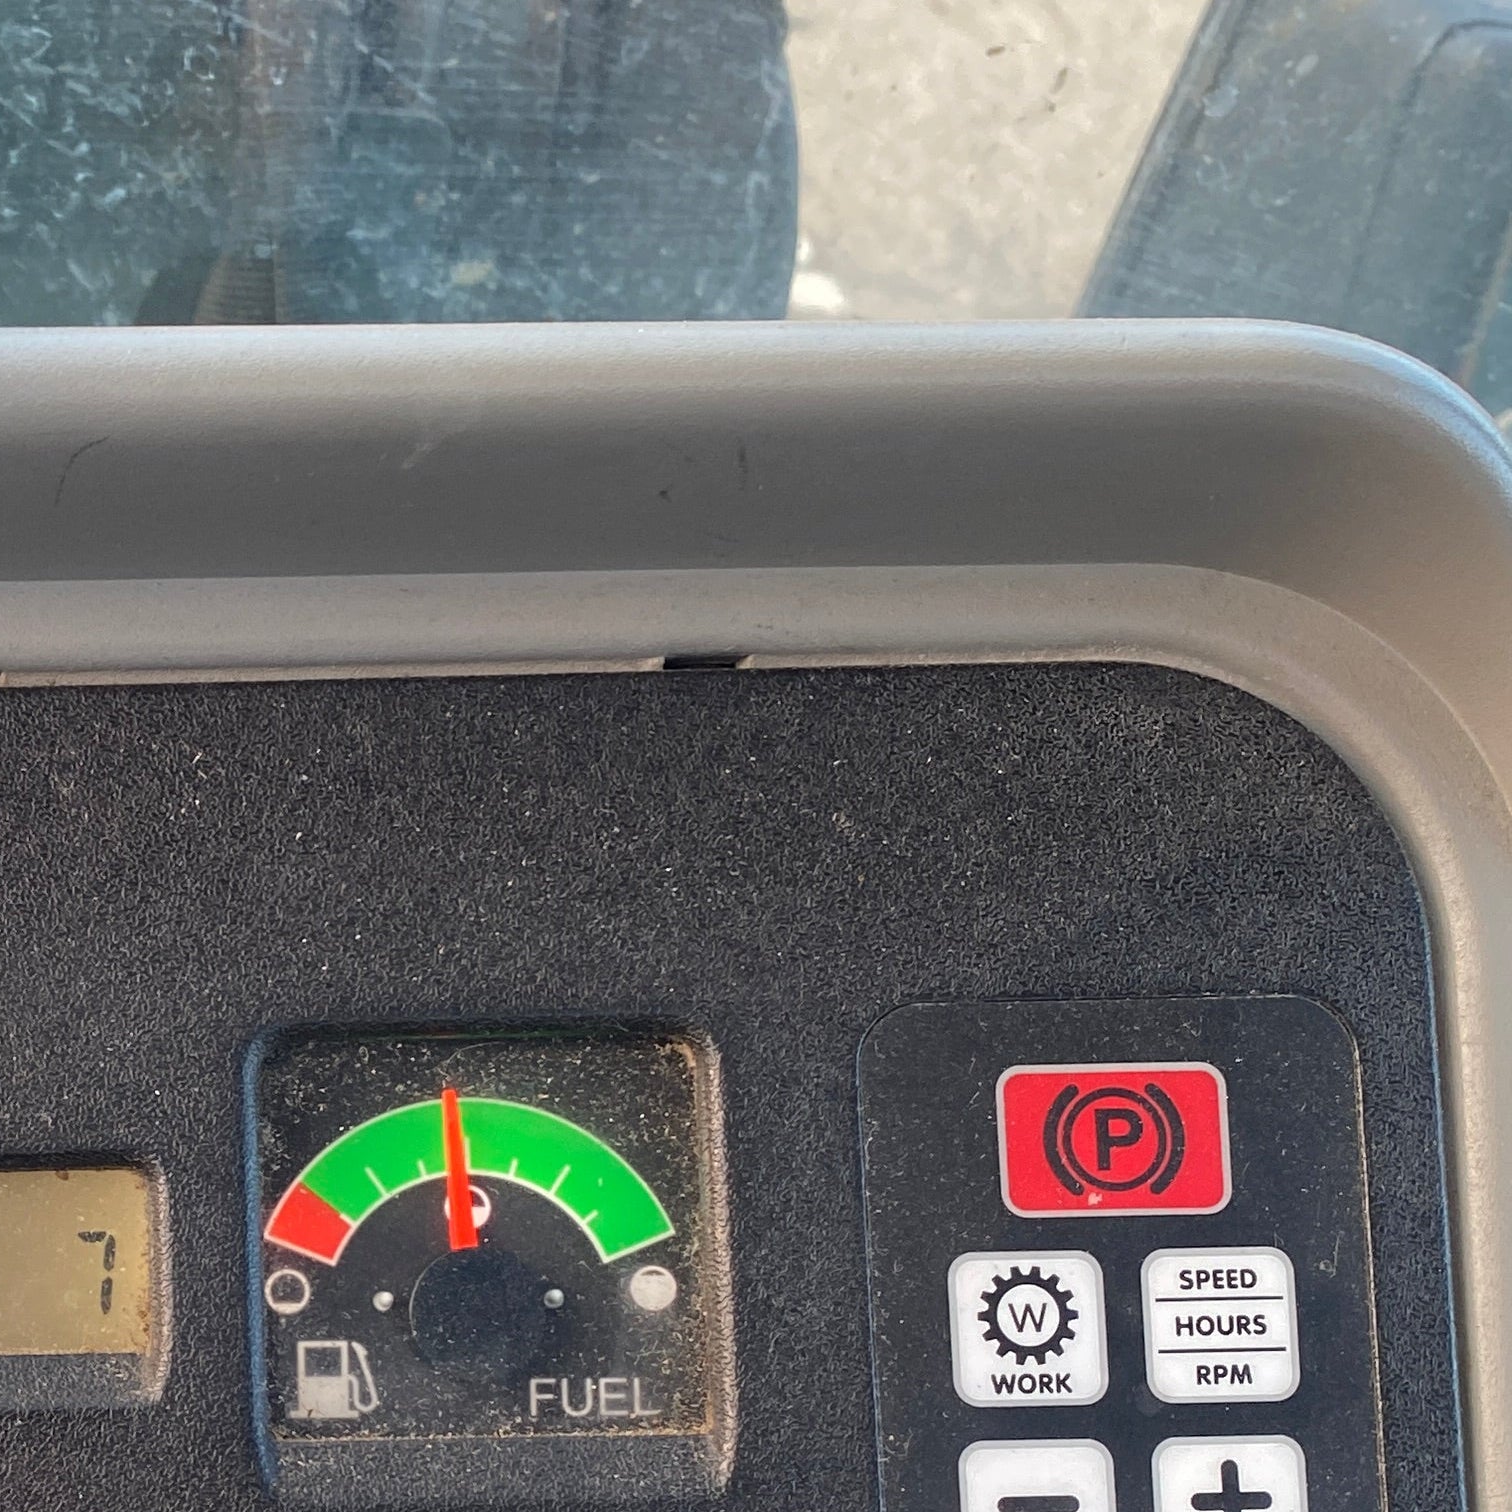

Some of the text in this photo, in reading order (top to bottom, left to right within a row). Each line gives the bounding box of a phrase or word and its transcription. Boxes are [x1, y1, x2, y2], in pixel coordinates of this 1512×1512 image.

[77, 1231, 117, 1315] 7
[1178, 1268, 1258, 1290] SPEED
[1007, 1301, 1048, 1333] W
[1174, 1314, 1268, 1337] HOURS
[990, 1372, 1074, 1395] WORK
[1195, 1363, 1254, 1386] RPM
[529, 1376, 663, 1418] FUEL
